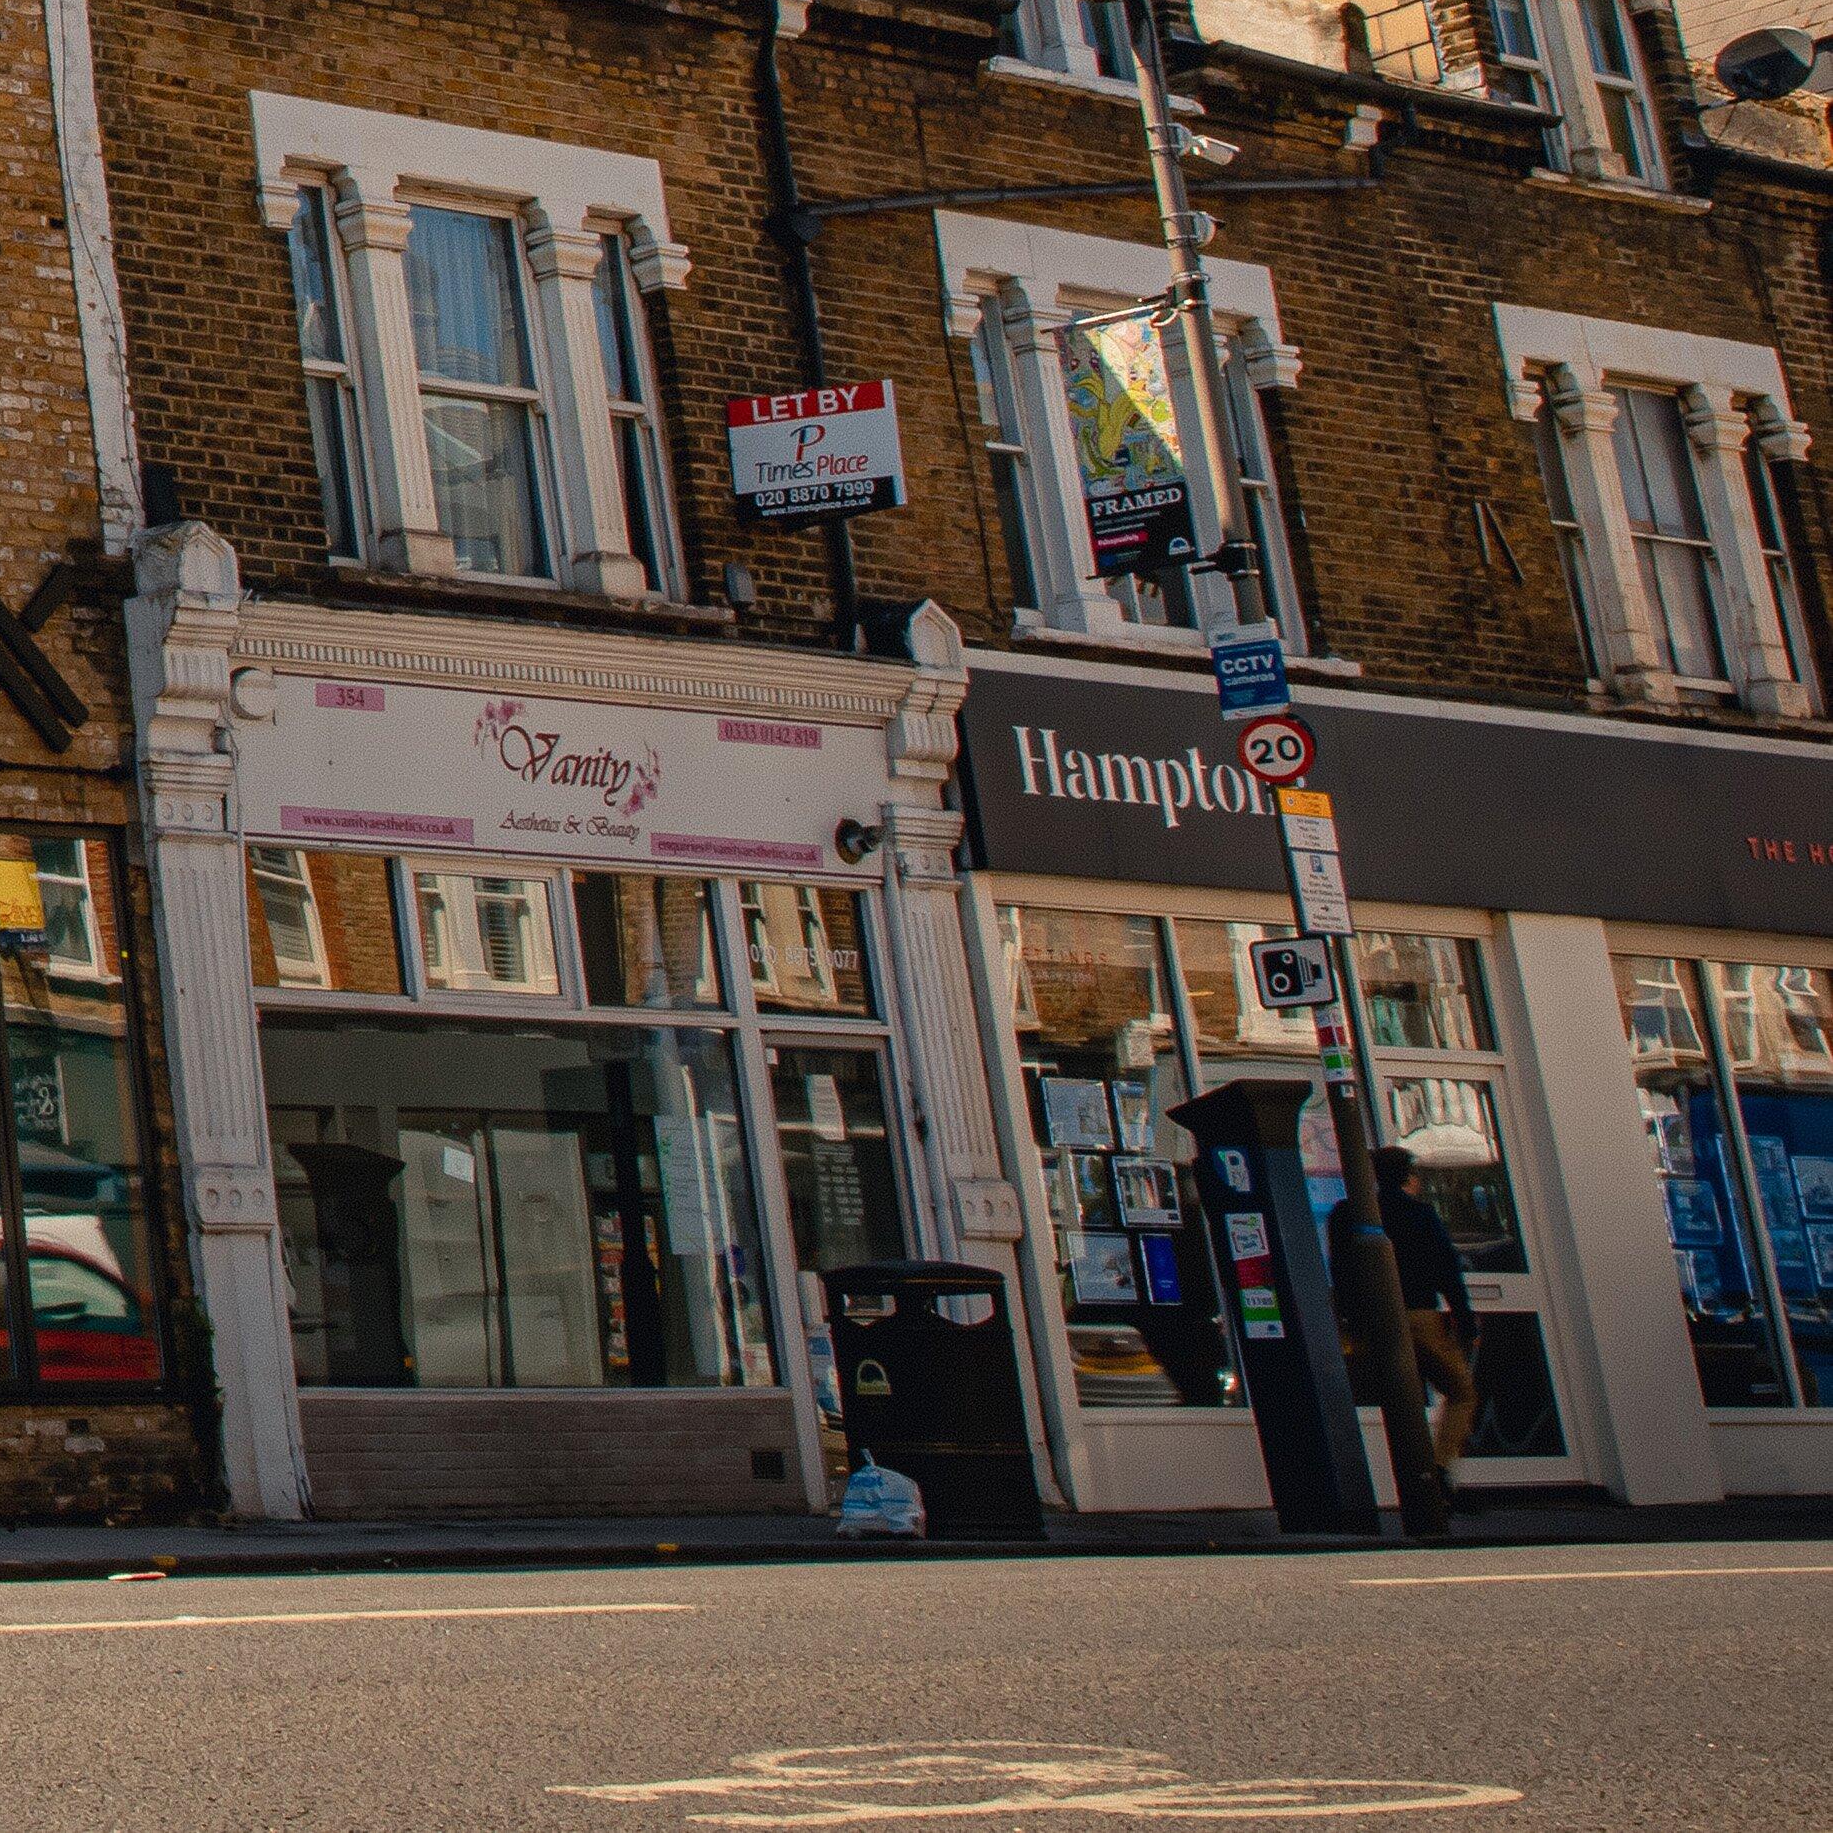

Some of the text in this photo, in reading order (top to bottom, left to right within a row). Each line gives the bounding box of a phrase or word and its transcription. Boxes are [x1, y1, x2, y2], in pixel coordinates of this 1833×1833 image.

[752, 386, 859, 422] LET BY
[755, 480, 875, 507] 020 8870 7999
[1091, 487, 1182, 517] FRAMED
[1220, 653, 1274, 674] CCTV
[1224, 672, 1276, 686] cameras
[335, 687, 365, 707] 354
[1250, 734, 1302, 765] 20
[499, 724, 632, 807] Vanity
[1012, 725, 1277, 829] Hampton
[499, 809, 640, 845] Aesthetics & Beauty
[1746, 836, 1796, 864] THE
